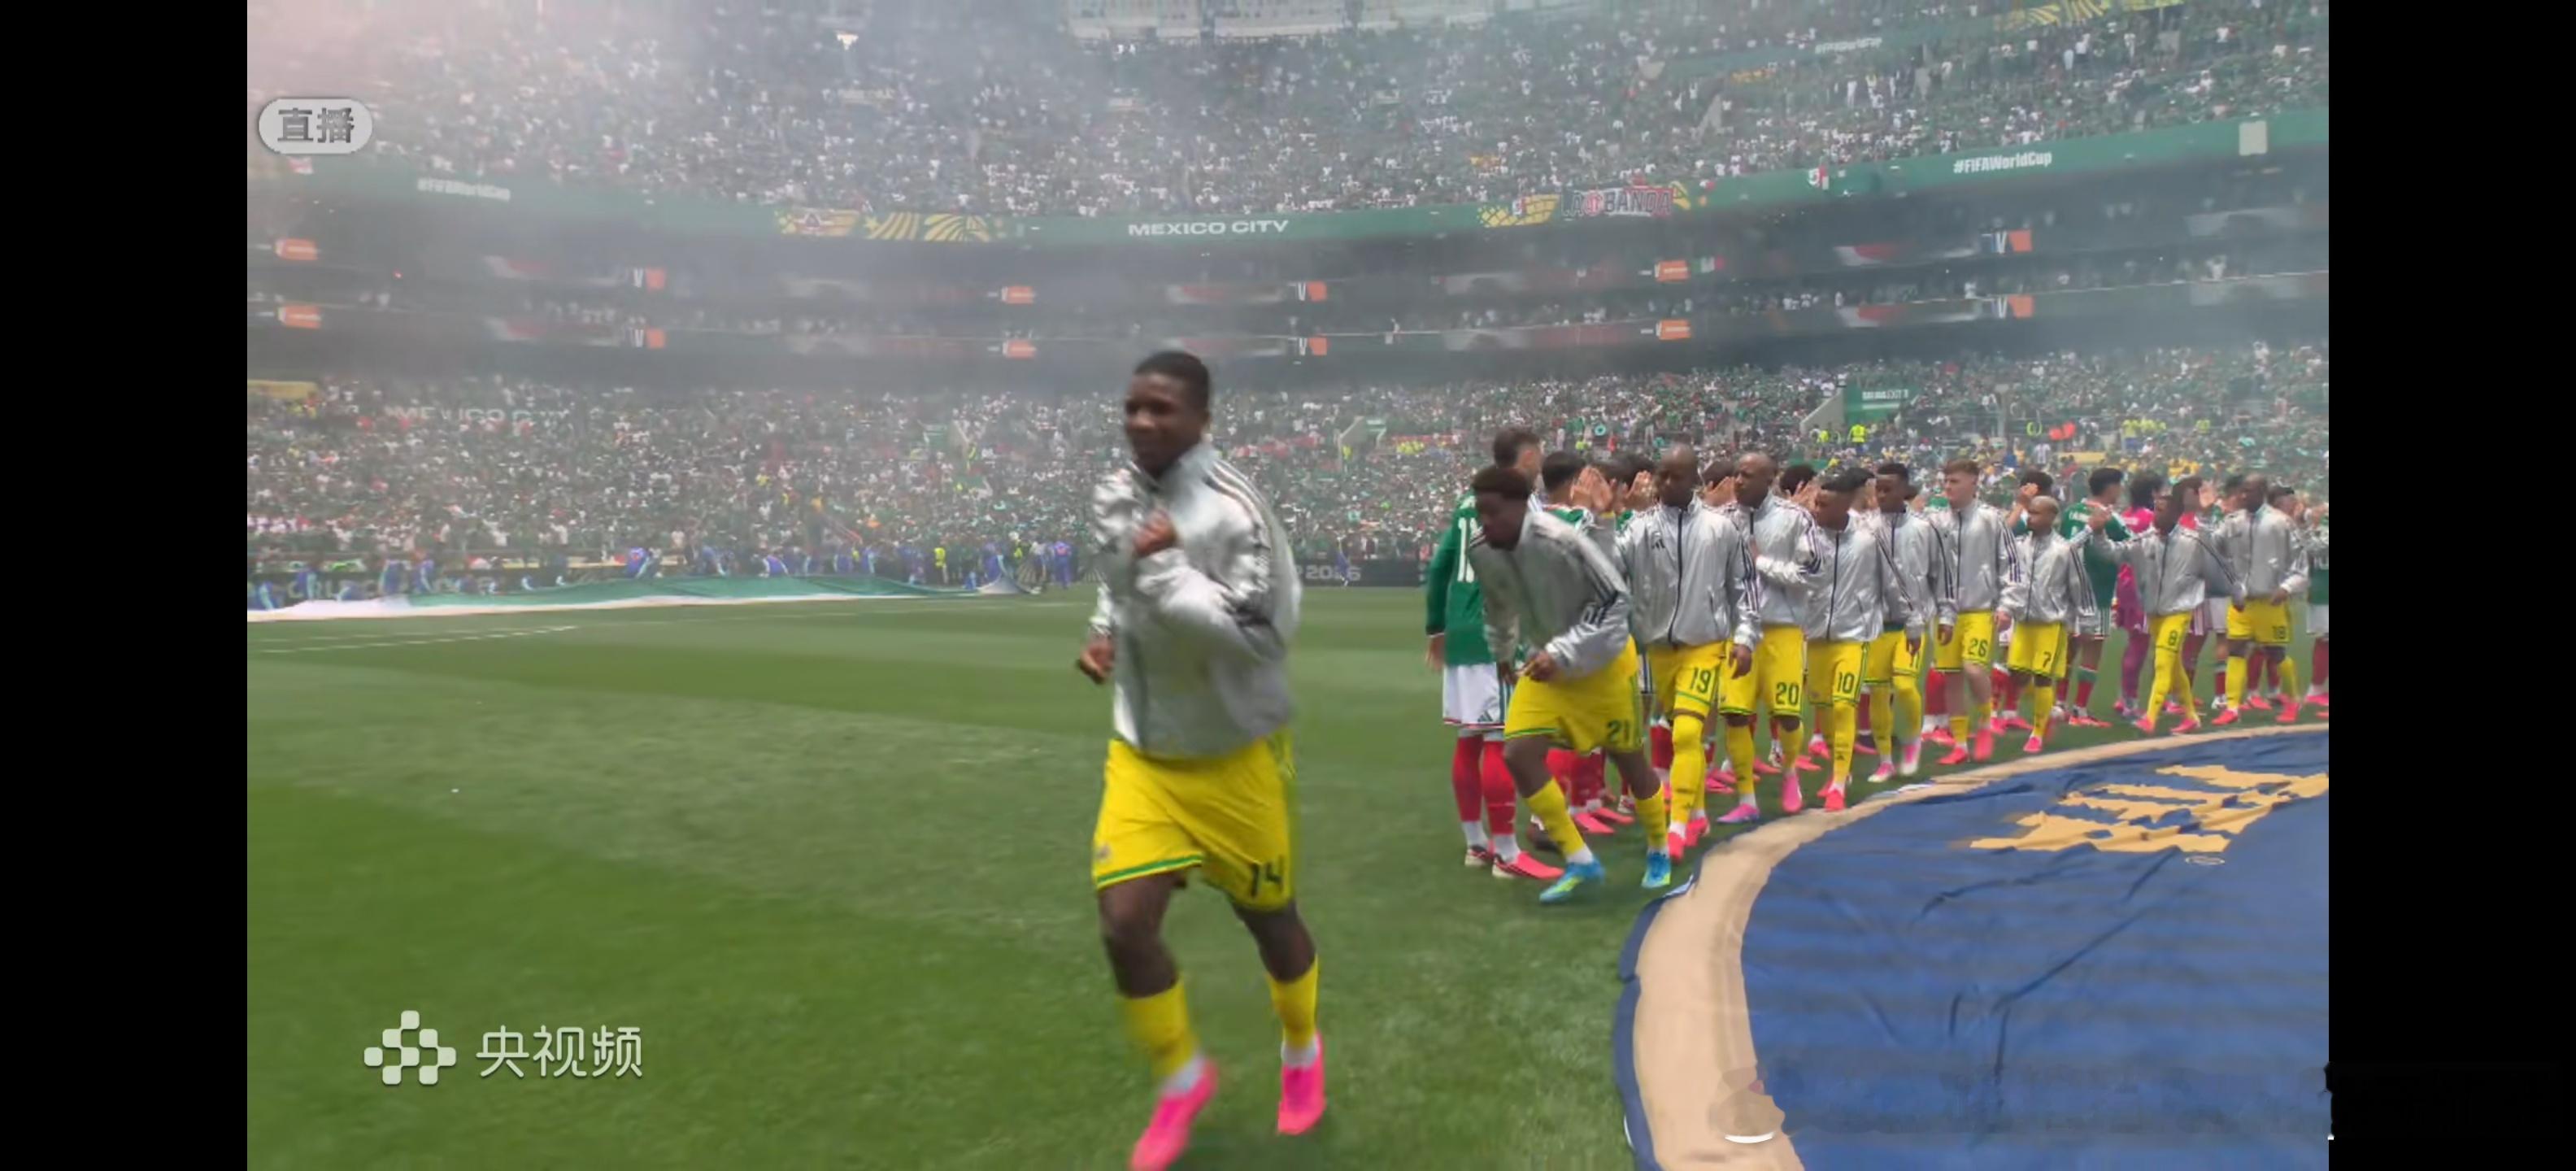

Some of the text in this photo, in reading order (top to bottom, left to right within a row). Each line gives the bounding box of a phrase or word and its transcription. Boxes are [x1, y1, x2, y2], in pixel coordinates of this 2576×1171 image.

[1953, 151, 2052, 173] #FIFAWorldCup
[1604, 187, 1672, 217] BANDA
[1128, 220, 1289, 236] MEXICO CITY
[1305, 565, 1361, 581] 206
[1969, 638, 1988, 657] 26
[2043, 651, 2052, 668] 7
[1690, 667, 1712, 693] 19
[1838, 672, 1854, 694] 10
[1776, 682, 1799, 705] 20
[1607, 720, 1630, 743] 21
[1250, 855, 1283, 897] 14
